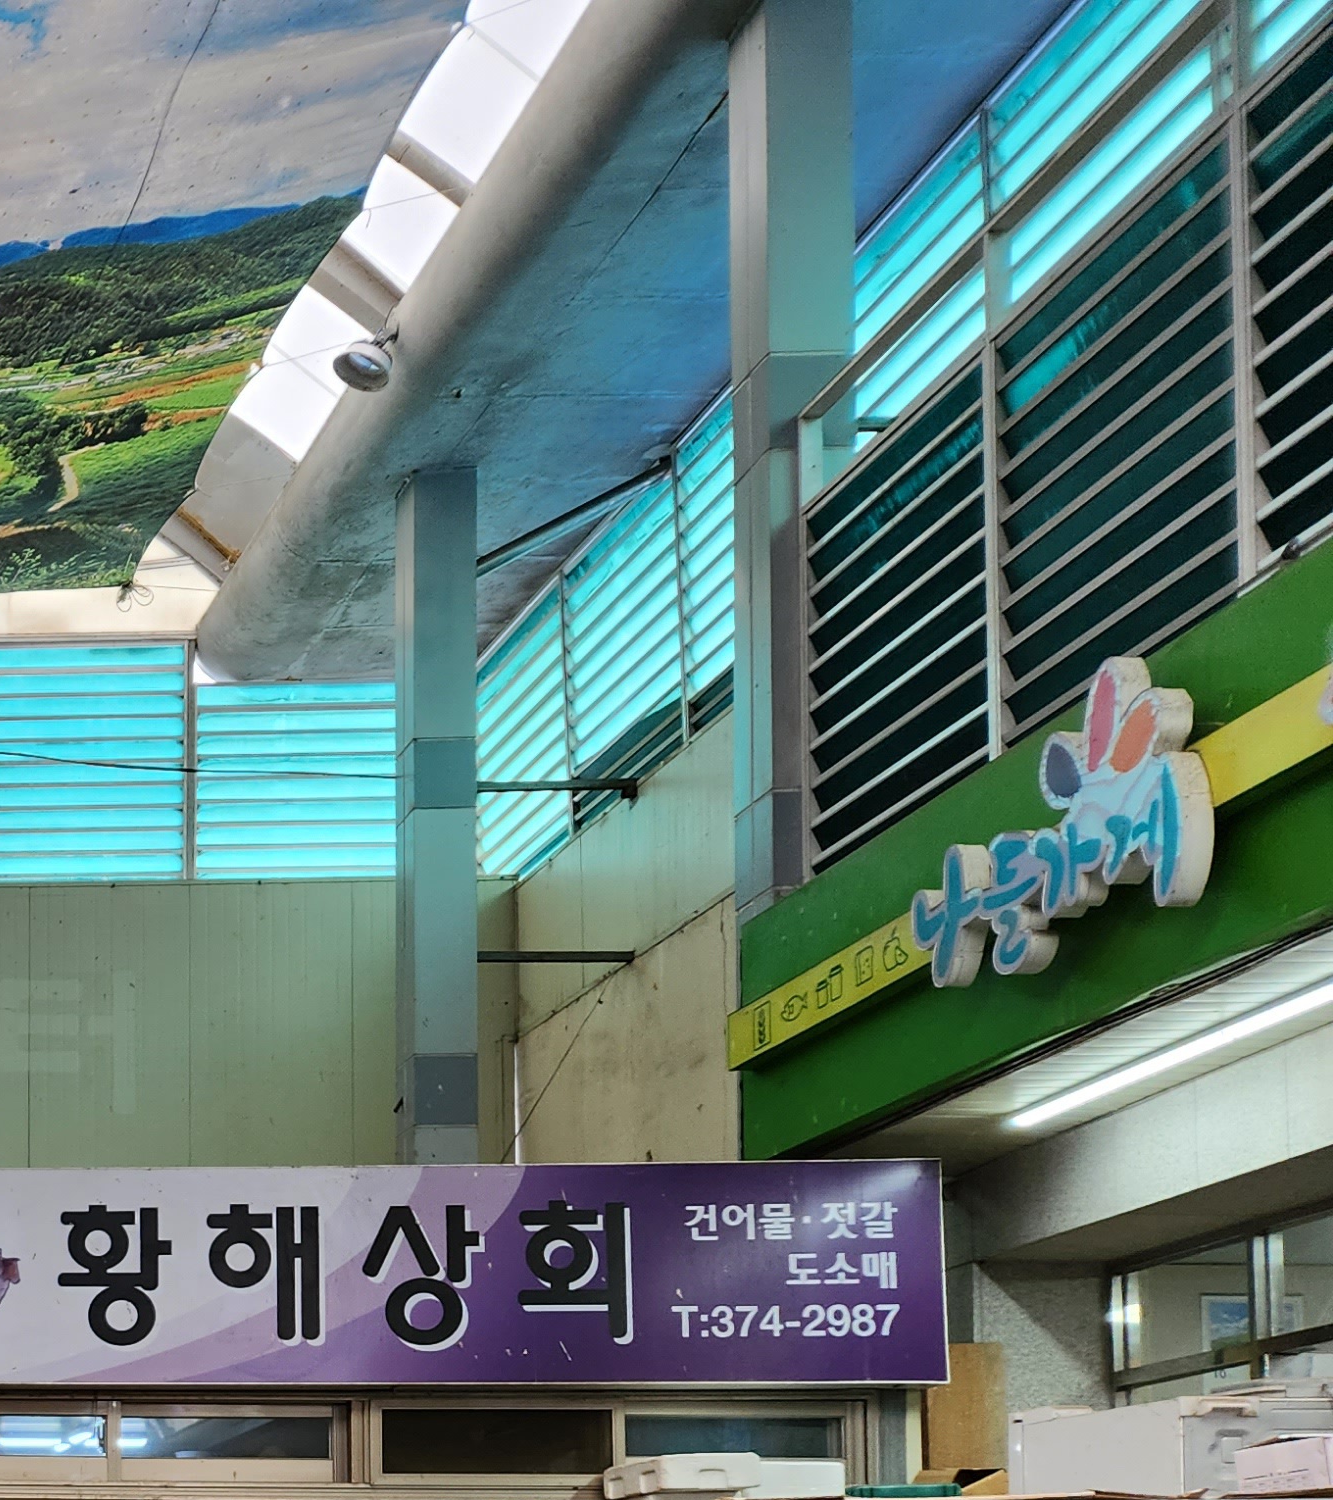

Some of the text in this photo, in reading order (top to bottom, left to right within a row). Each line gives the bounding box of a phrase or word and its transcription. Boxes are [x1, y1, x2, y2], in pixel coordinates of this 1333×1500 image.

[916, 757, 1179, 980] 나들가게
[56, 1200, 635, 1350] 황해상회
[785, 1250, 899, 1290] 도소매
[670, 1303, 901, 1338] T:374-2987
